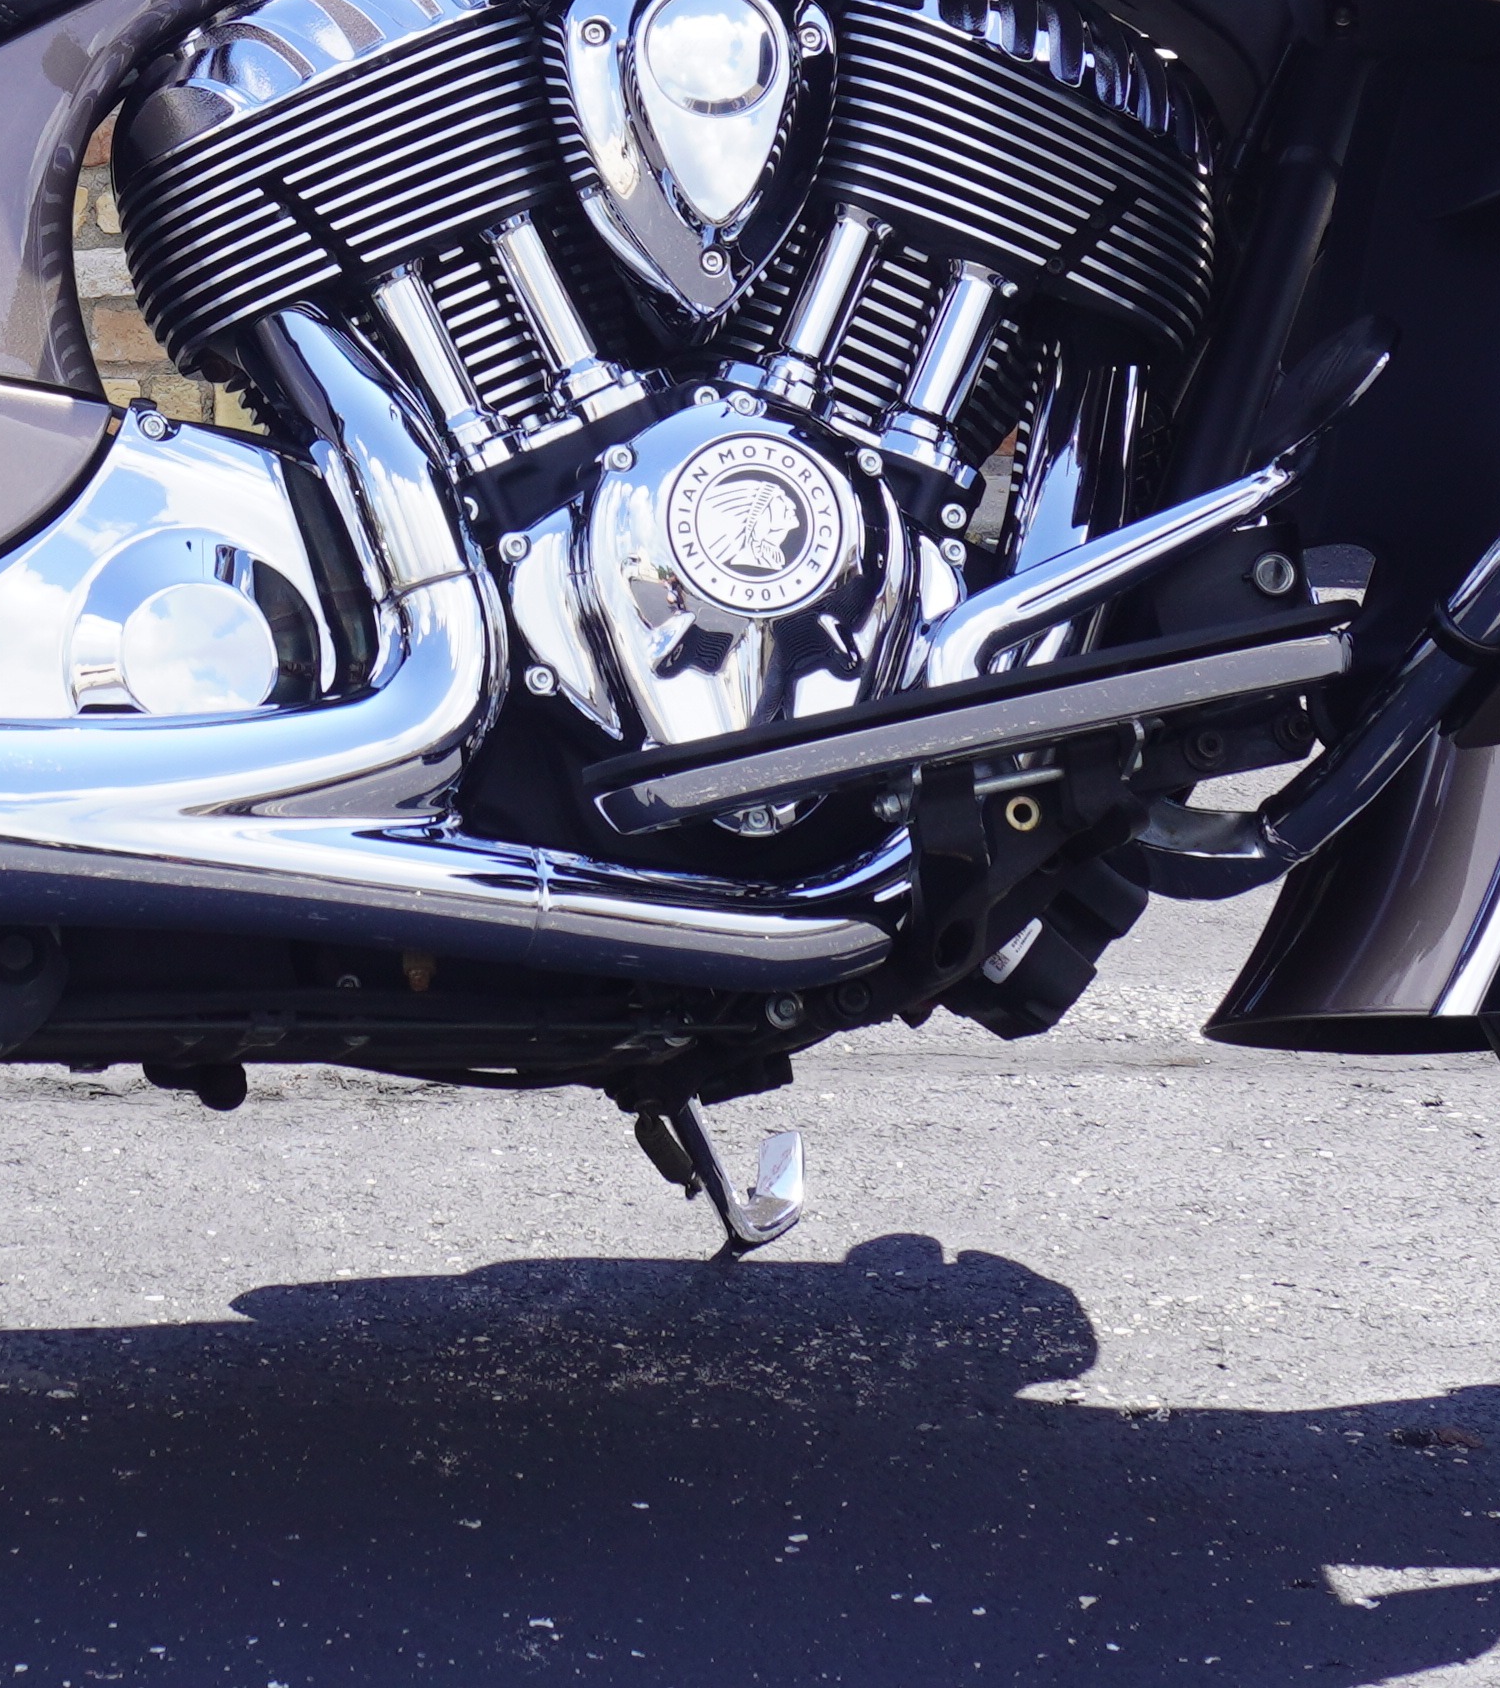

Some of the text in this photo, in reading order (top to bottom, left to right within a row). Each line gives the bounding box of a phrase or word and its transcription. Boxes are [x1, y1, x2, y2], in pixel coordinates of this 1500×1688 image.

[678, 445, 833, 573] INDIAN MOTORCYCLE
[730, 584, 786, 601] 1901
